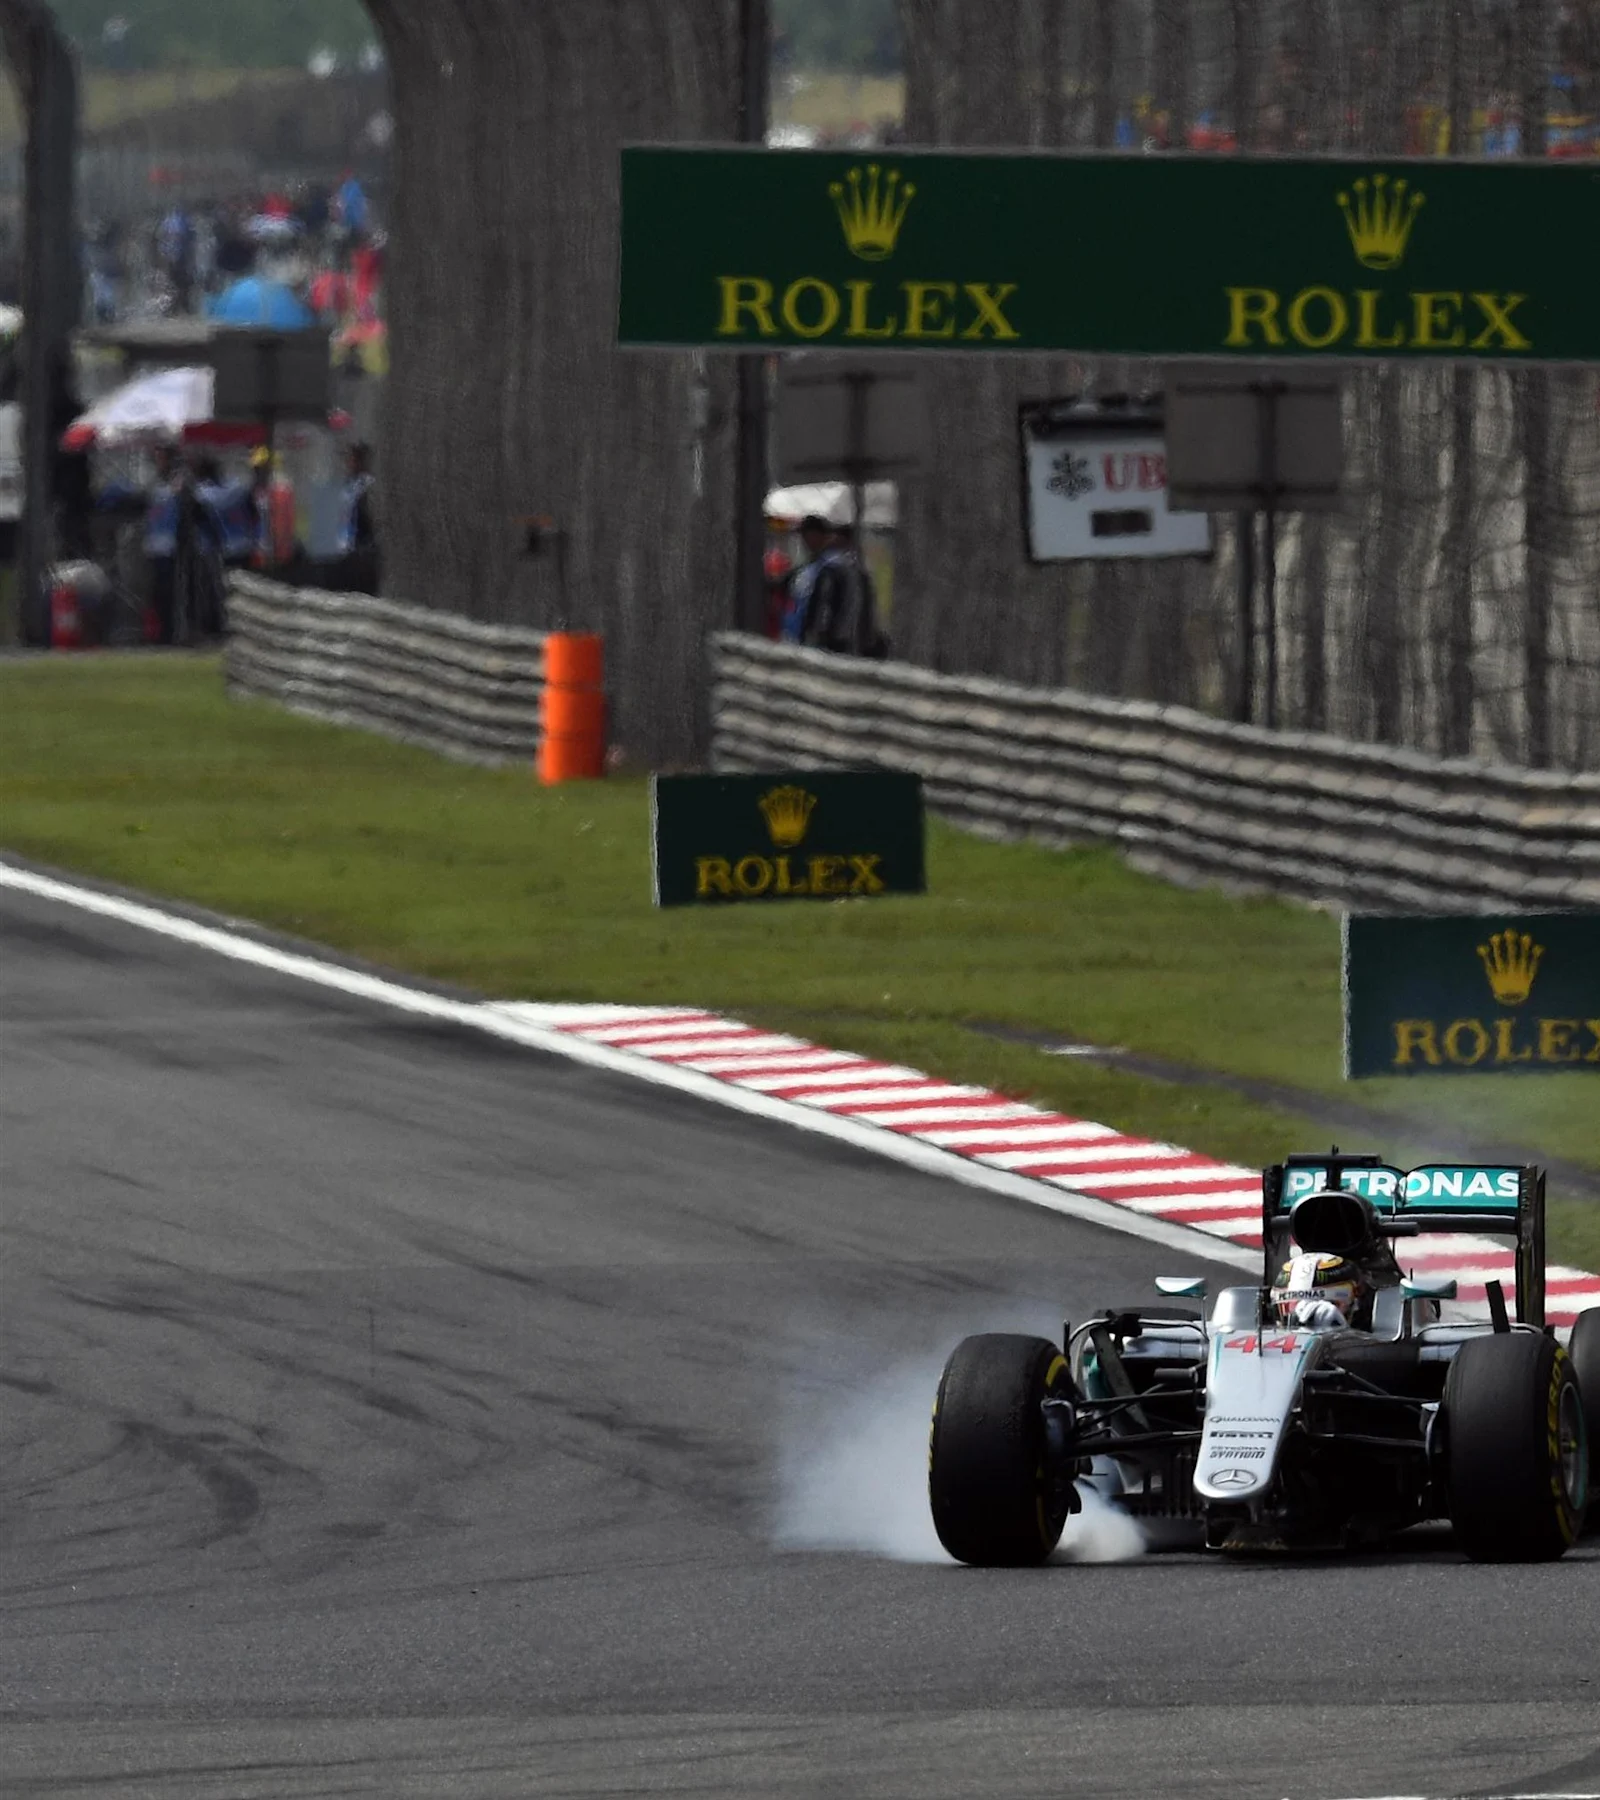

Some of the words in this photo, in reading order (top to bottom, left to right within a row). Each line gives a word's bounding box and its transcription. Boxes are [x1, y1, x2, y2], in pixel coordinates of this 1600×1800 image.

[717, 277, 1018, 340] ROLEX
[1225, 287, 1532, 350] ROLEX
[1103, 453, 1167, 492] UB
[695, 855, 884, 895] ROLEX
[1279, 1290, 1325, 1300] PETRONAS
[1224, 1334, 1301, 1353] 44
